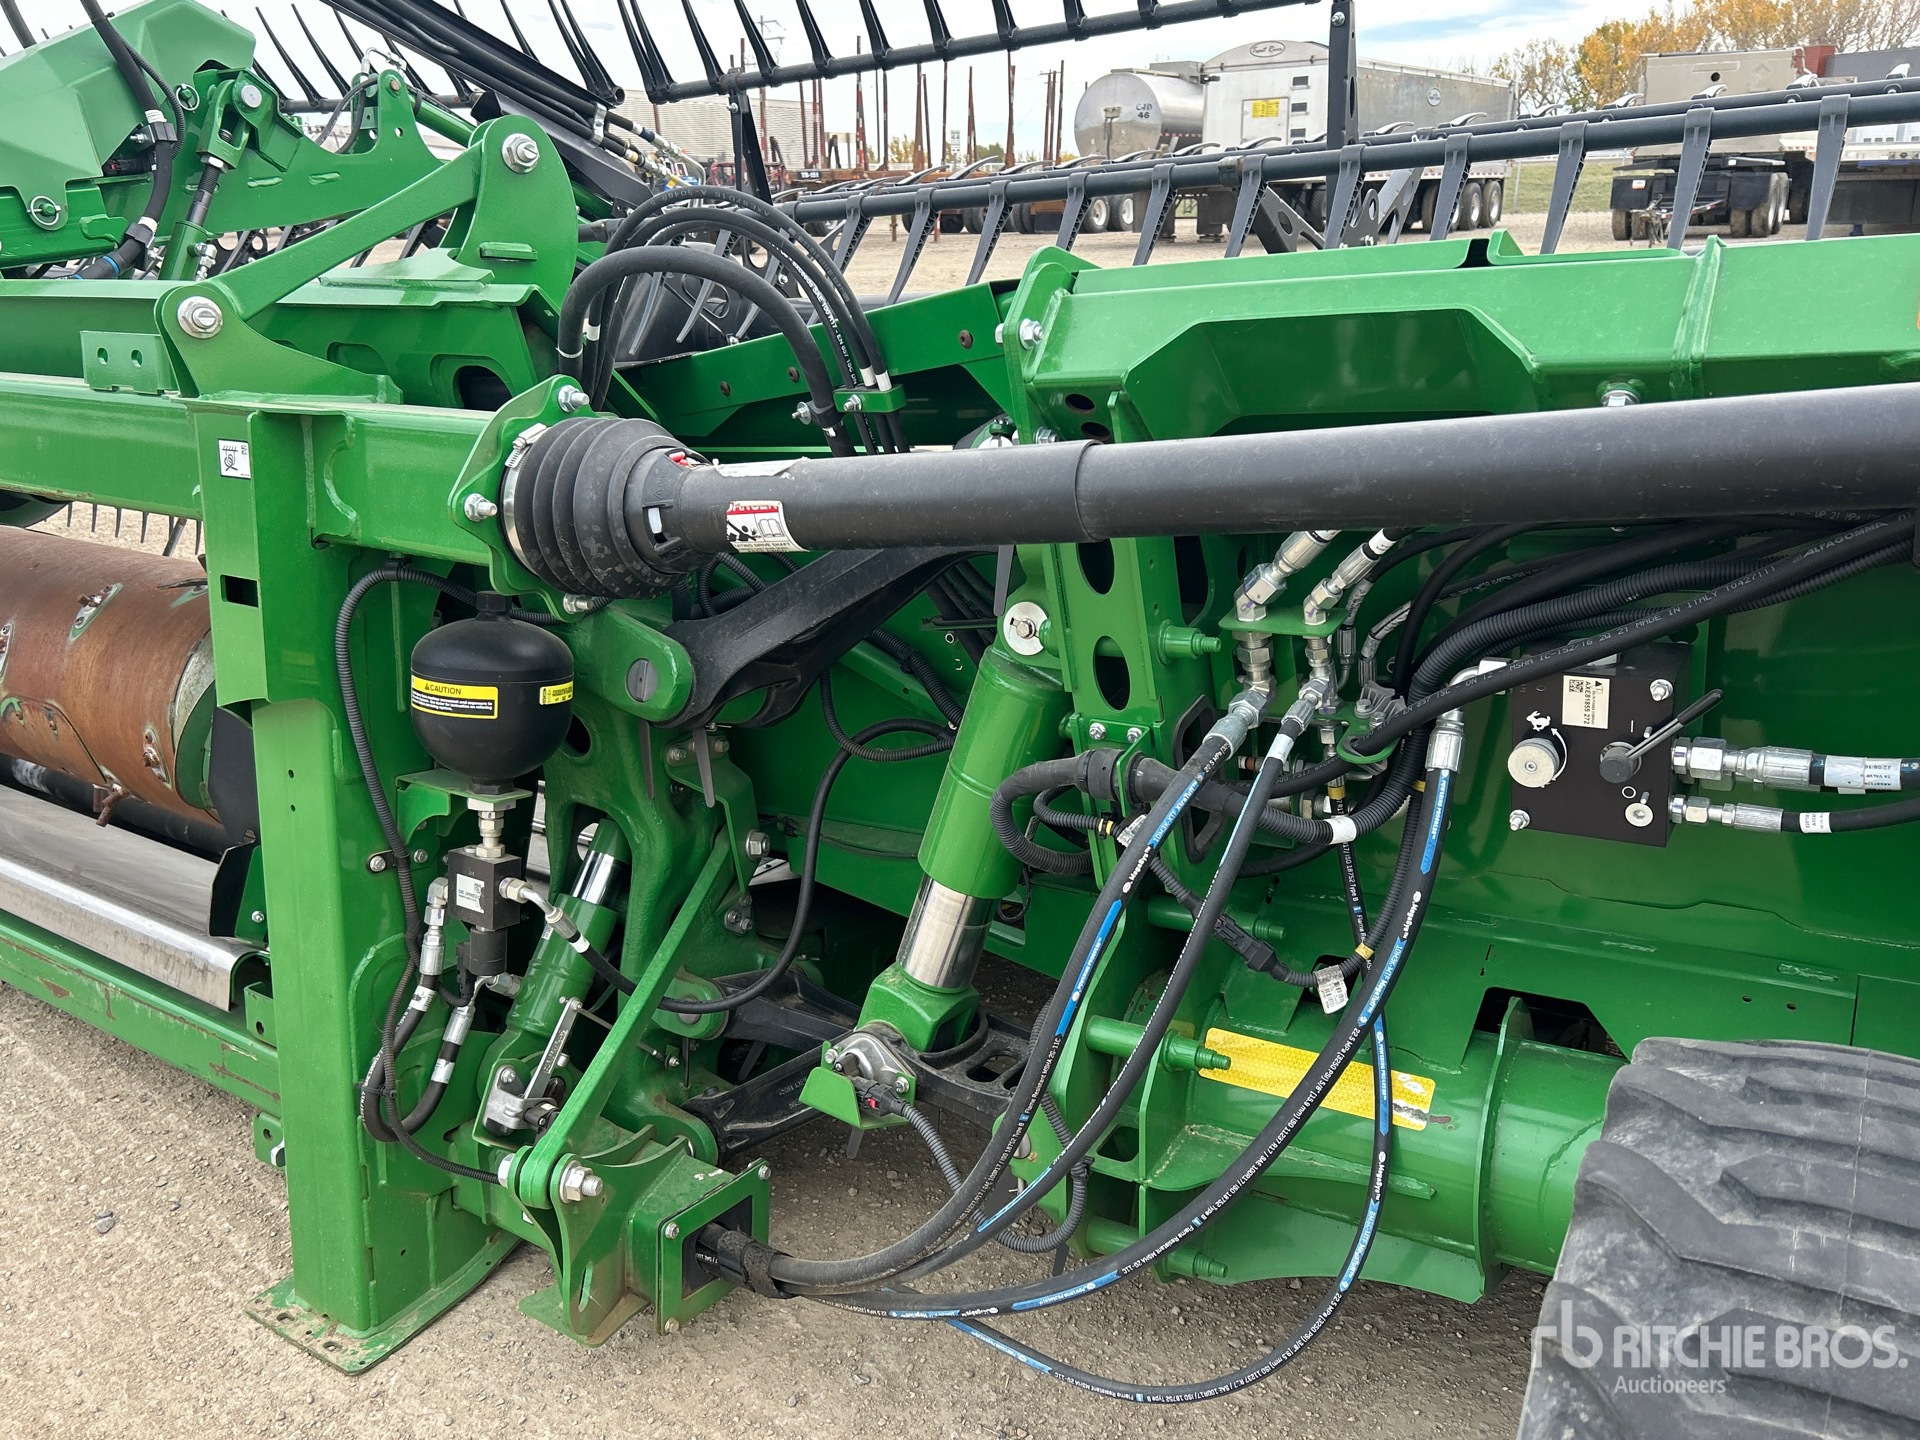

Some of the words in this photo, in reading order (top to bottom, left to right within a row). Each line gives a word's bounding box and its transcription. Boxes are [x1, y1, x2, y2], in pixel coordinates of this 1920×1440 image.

[1137, 111, 1150, 119] 46
[836, 333, 845, 345] EN
[1464, 677, 1478, 687] DN
[1634, 612, 1662, 630] MADE
[1667, 605, 1681, 617] IN
[1685, 589, 1719, 610] ITALY
[1801, 519, 1889, 559] ALFAGOMMA
[429, 684, 462, 695] CAUTION
[1346, 864, 1355, 883] 18752
[1348, 883, 1358, 897] Type
[1356, 914, 1366, 932] Flame
[1348, 1027, 1361, 1042] 22.5
[1340, 1039, 1353, 1055] MPa
[1024, 1097, 1036, 1115] Flame
[1031, 1073, 1047, 1099] Resistant
[1287, 1116, 1298, 1129] ISO
[1012, 1125, 1023, 1139] Type
[1274, 1125, 1292, 1145] 11237
[1265, 1141, 1279, 1155] R17
[1254, 1154, 1268, 1168] SAE
[1228, 1182, 1241, 1195] ISO
[1214, 1191, 1233, 1208] 18752
[1203, 1203, 1219, 1218] Type
[1177, 1224, 1195, 1240] Flame
[1154, 1235, 1181, 1255] Resistant
[1330, 1292, 1343, 1307] 22.5
[1322, 1304, 1335, 1319] MPa
[1243, 1369, 1263, 1384] 11237
[1260, 1364, 1271, 1374] ISO
